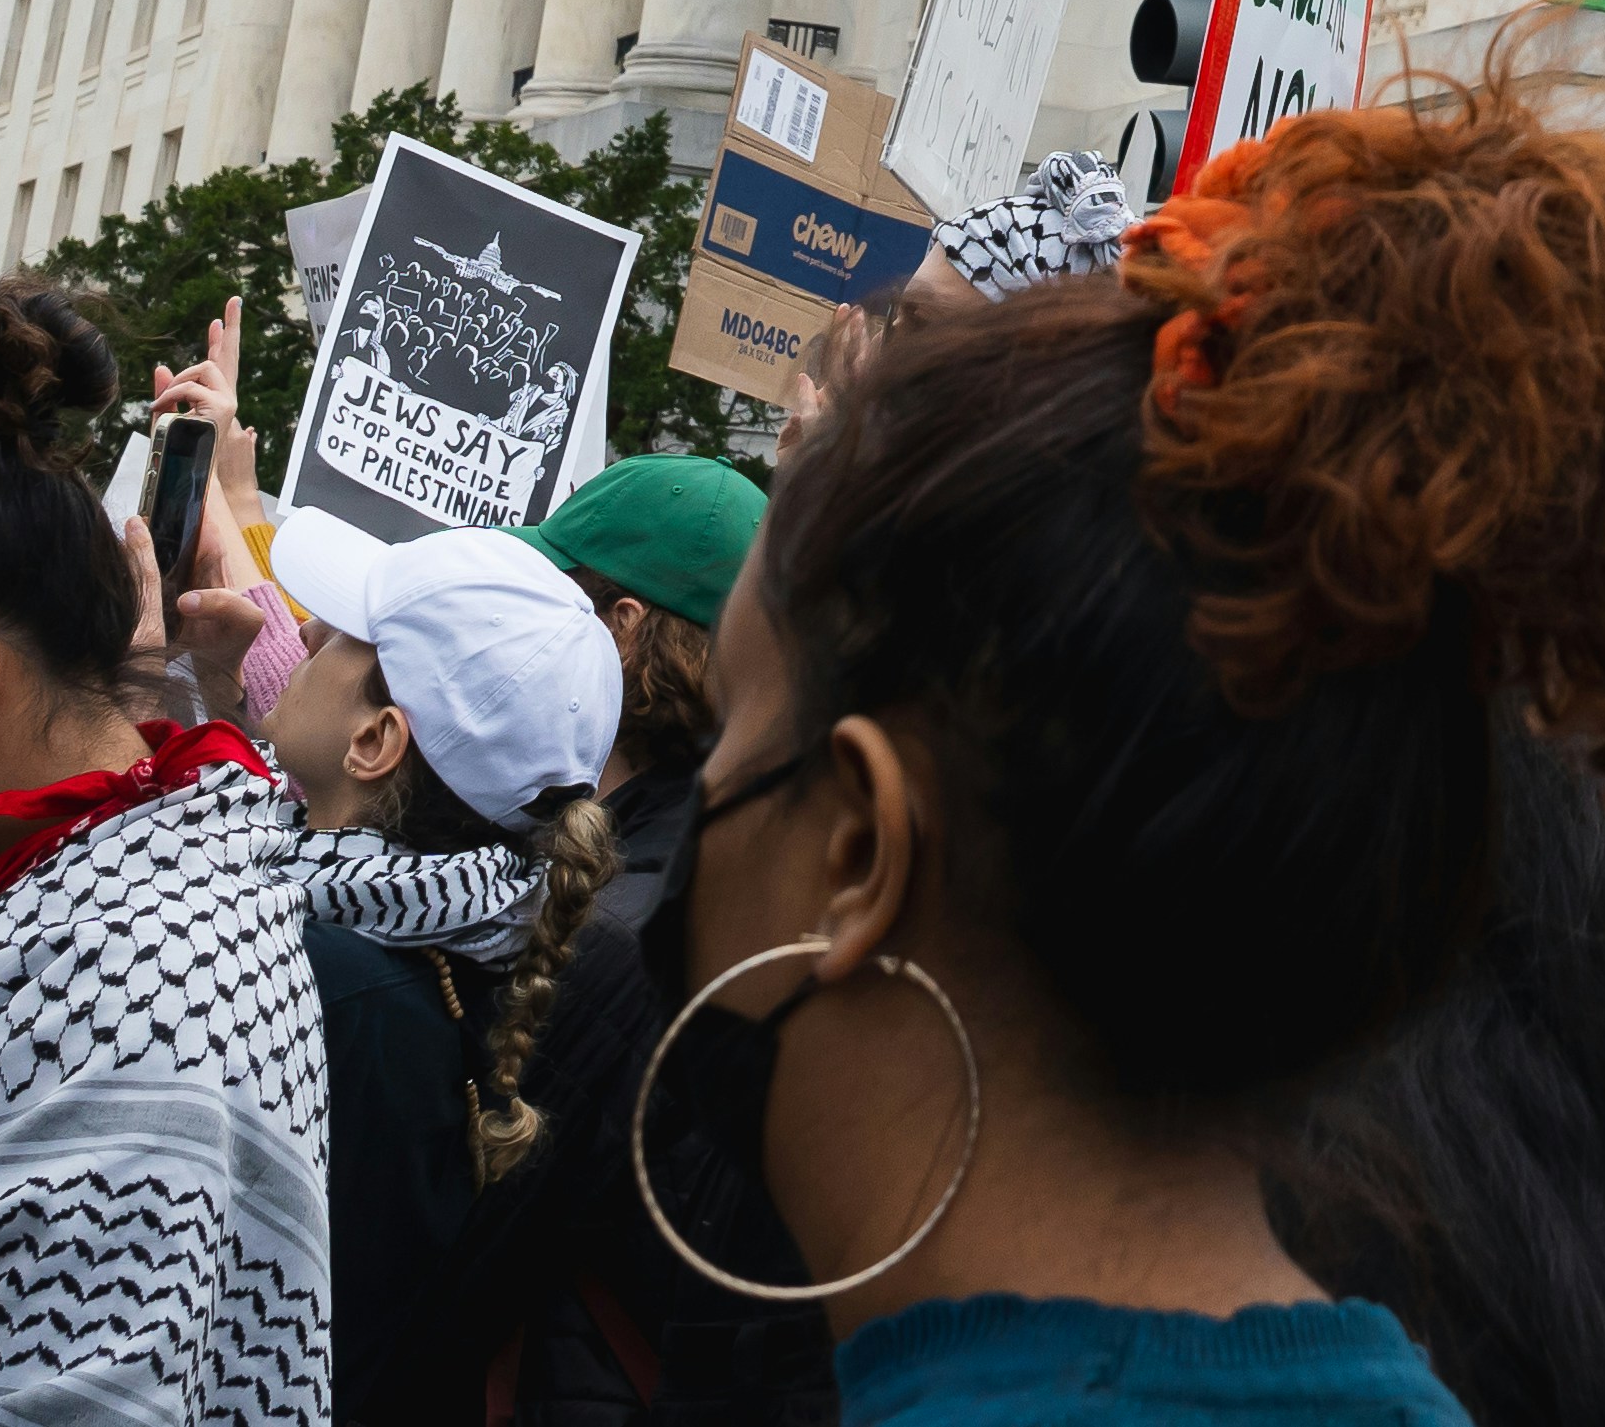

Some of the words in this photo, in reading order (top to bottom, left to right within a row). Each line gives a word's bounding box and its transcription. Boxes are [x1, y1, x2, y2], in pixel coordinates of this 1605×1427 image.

[793, 212, 868, 269] chewy
[304, 263, 340, 303] JEWS
[720, 307, 801, 359] MD04BC
[333, 405, 390, 444] STOP
[395, 436, 512, 501] GENOCIDE
[344, 375, 441, 437] JEWS
[444, 419, 529, 476] SAY
[327, 434, 362, 457] OF
[361, 446, 522, 527] PALESTINIANS
